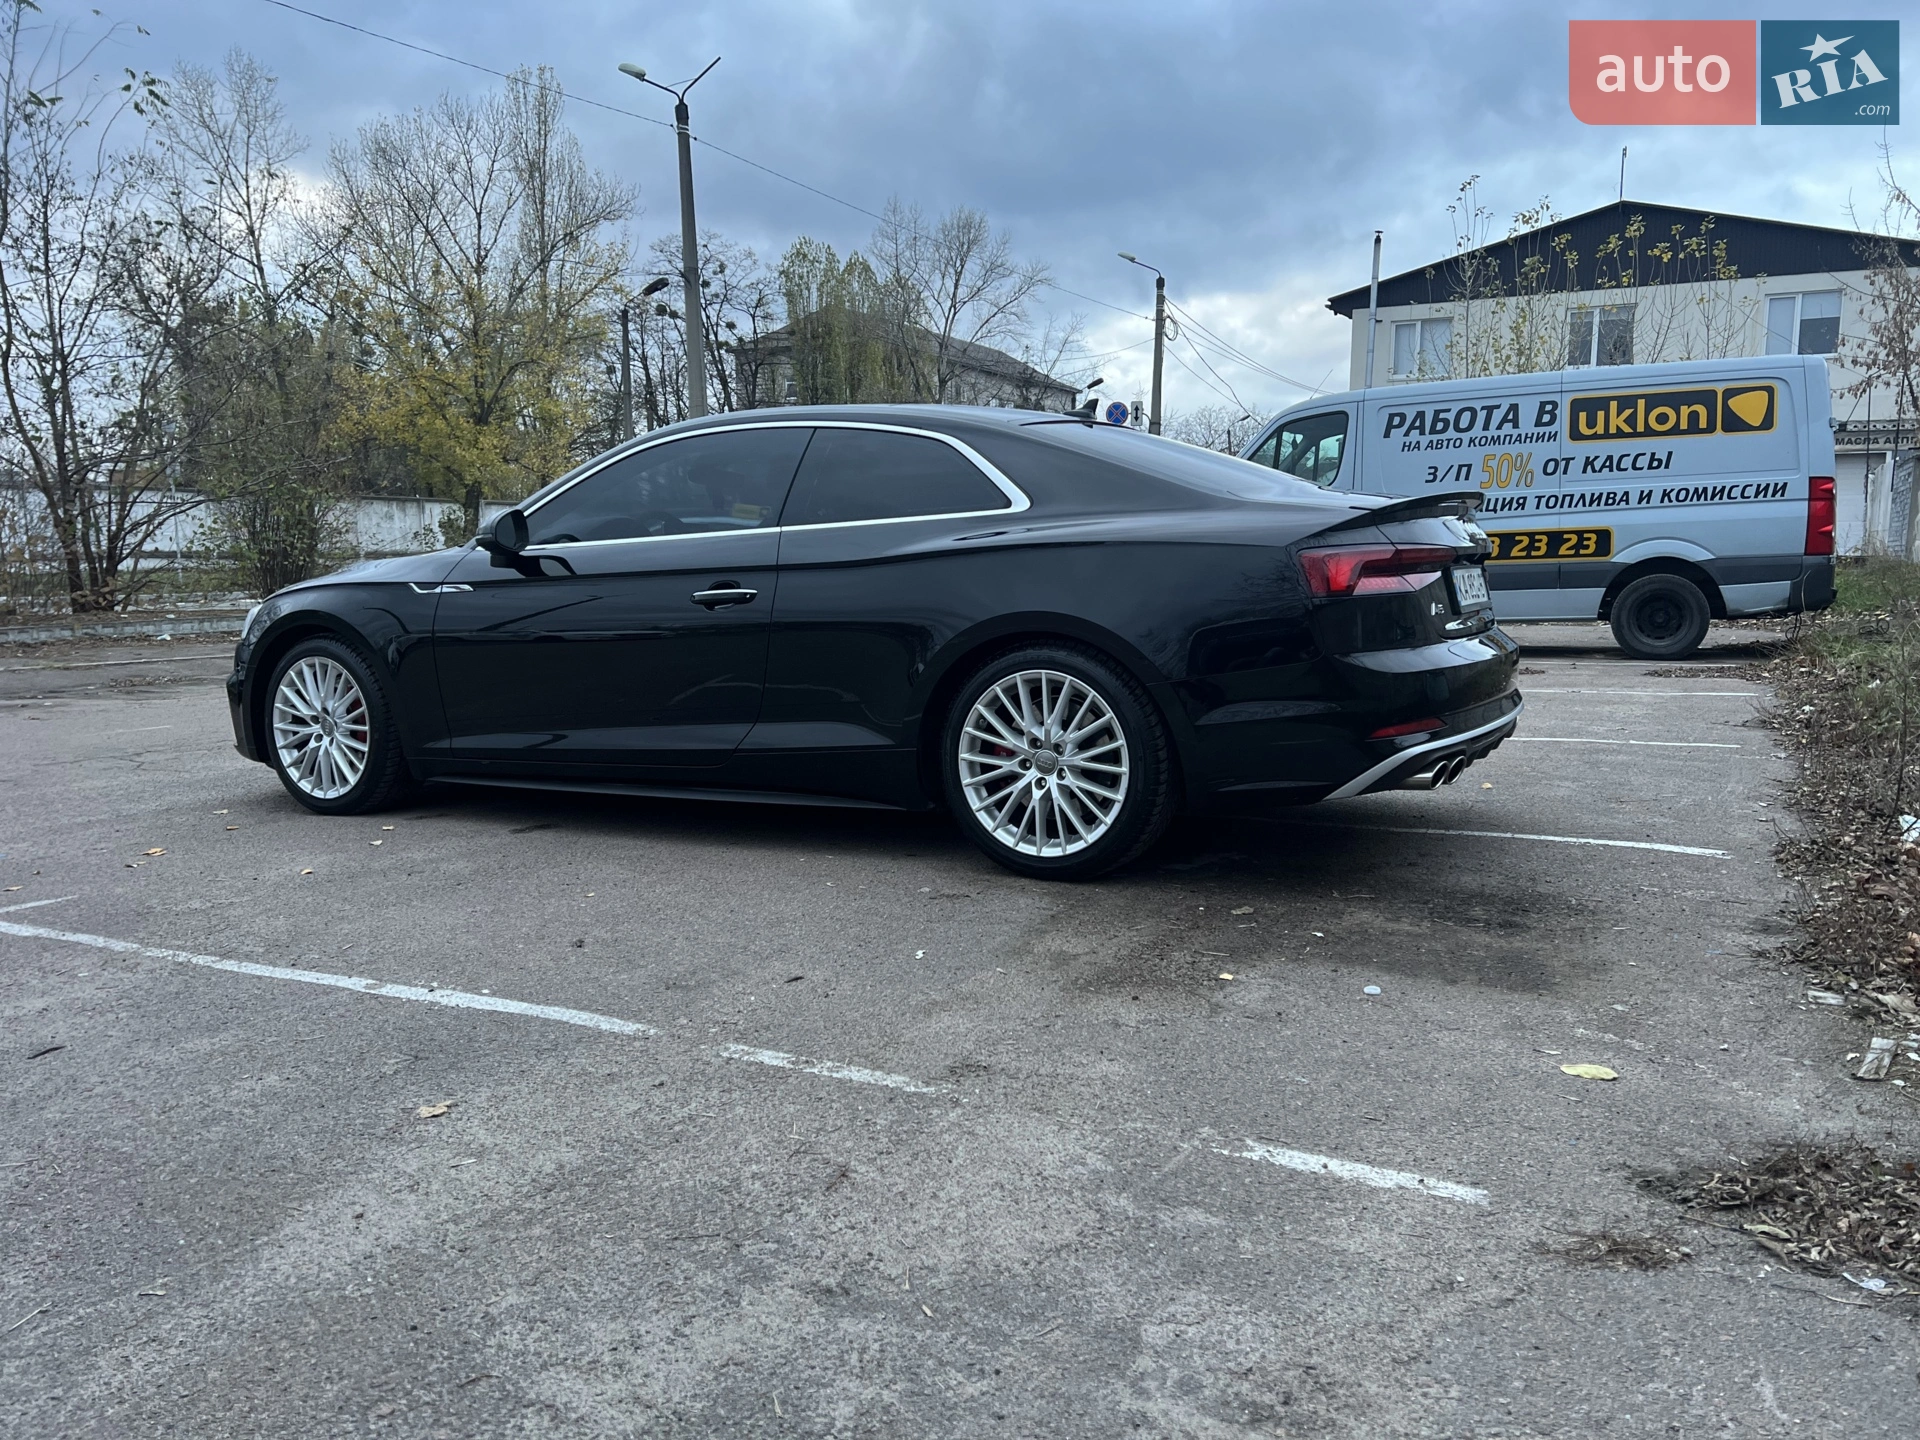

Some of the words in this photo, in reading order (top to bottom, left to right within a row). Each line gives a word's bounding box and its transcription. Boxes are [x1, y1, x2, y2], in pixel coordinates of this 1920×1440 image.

[1383, 403, 1521, 439] РАБОТА
[1534, 400, 1559, 428] В
[1578, 398, 1708, 436] uklon
[1401, 440, 1421, 452] НА
[1424, 437, 1464, 451] АВТО
[1467, 430, 1559, 448] КОМПАНИИ
[1835, 437, 1880, 446] МАСЛА
[1480, 452, 1535, 489] 50%
[1542, 456, 1576, 477] ОТ
[1581, 451, 1674, 474] КАССЫ
[1534, 491, 1630, 511] ТОПЛИВА
[1637, 489, 1654, 505] И
[1660, 482, 1789, 503] КОМИССИИ
[1510, 535, 1549, 557] 23
[1558, 533, 1598, 555] 23
